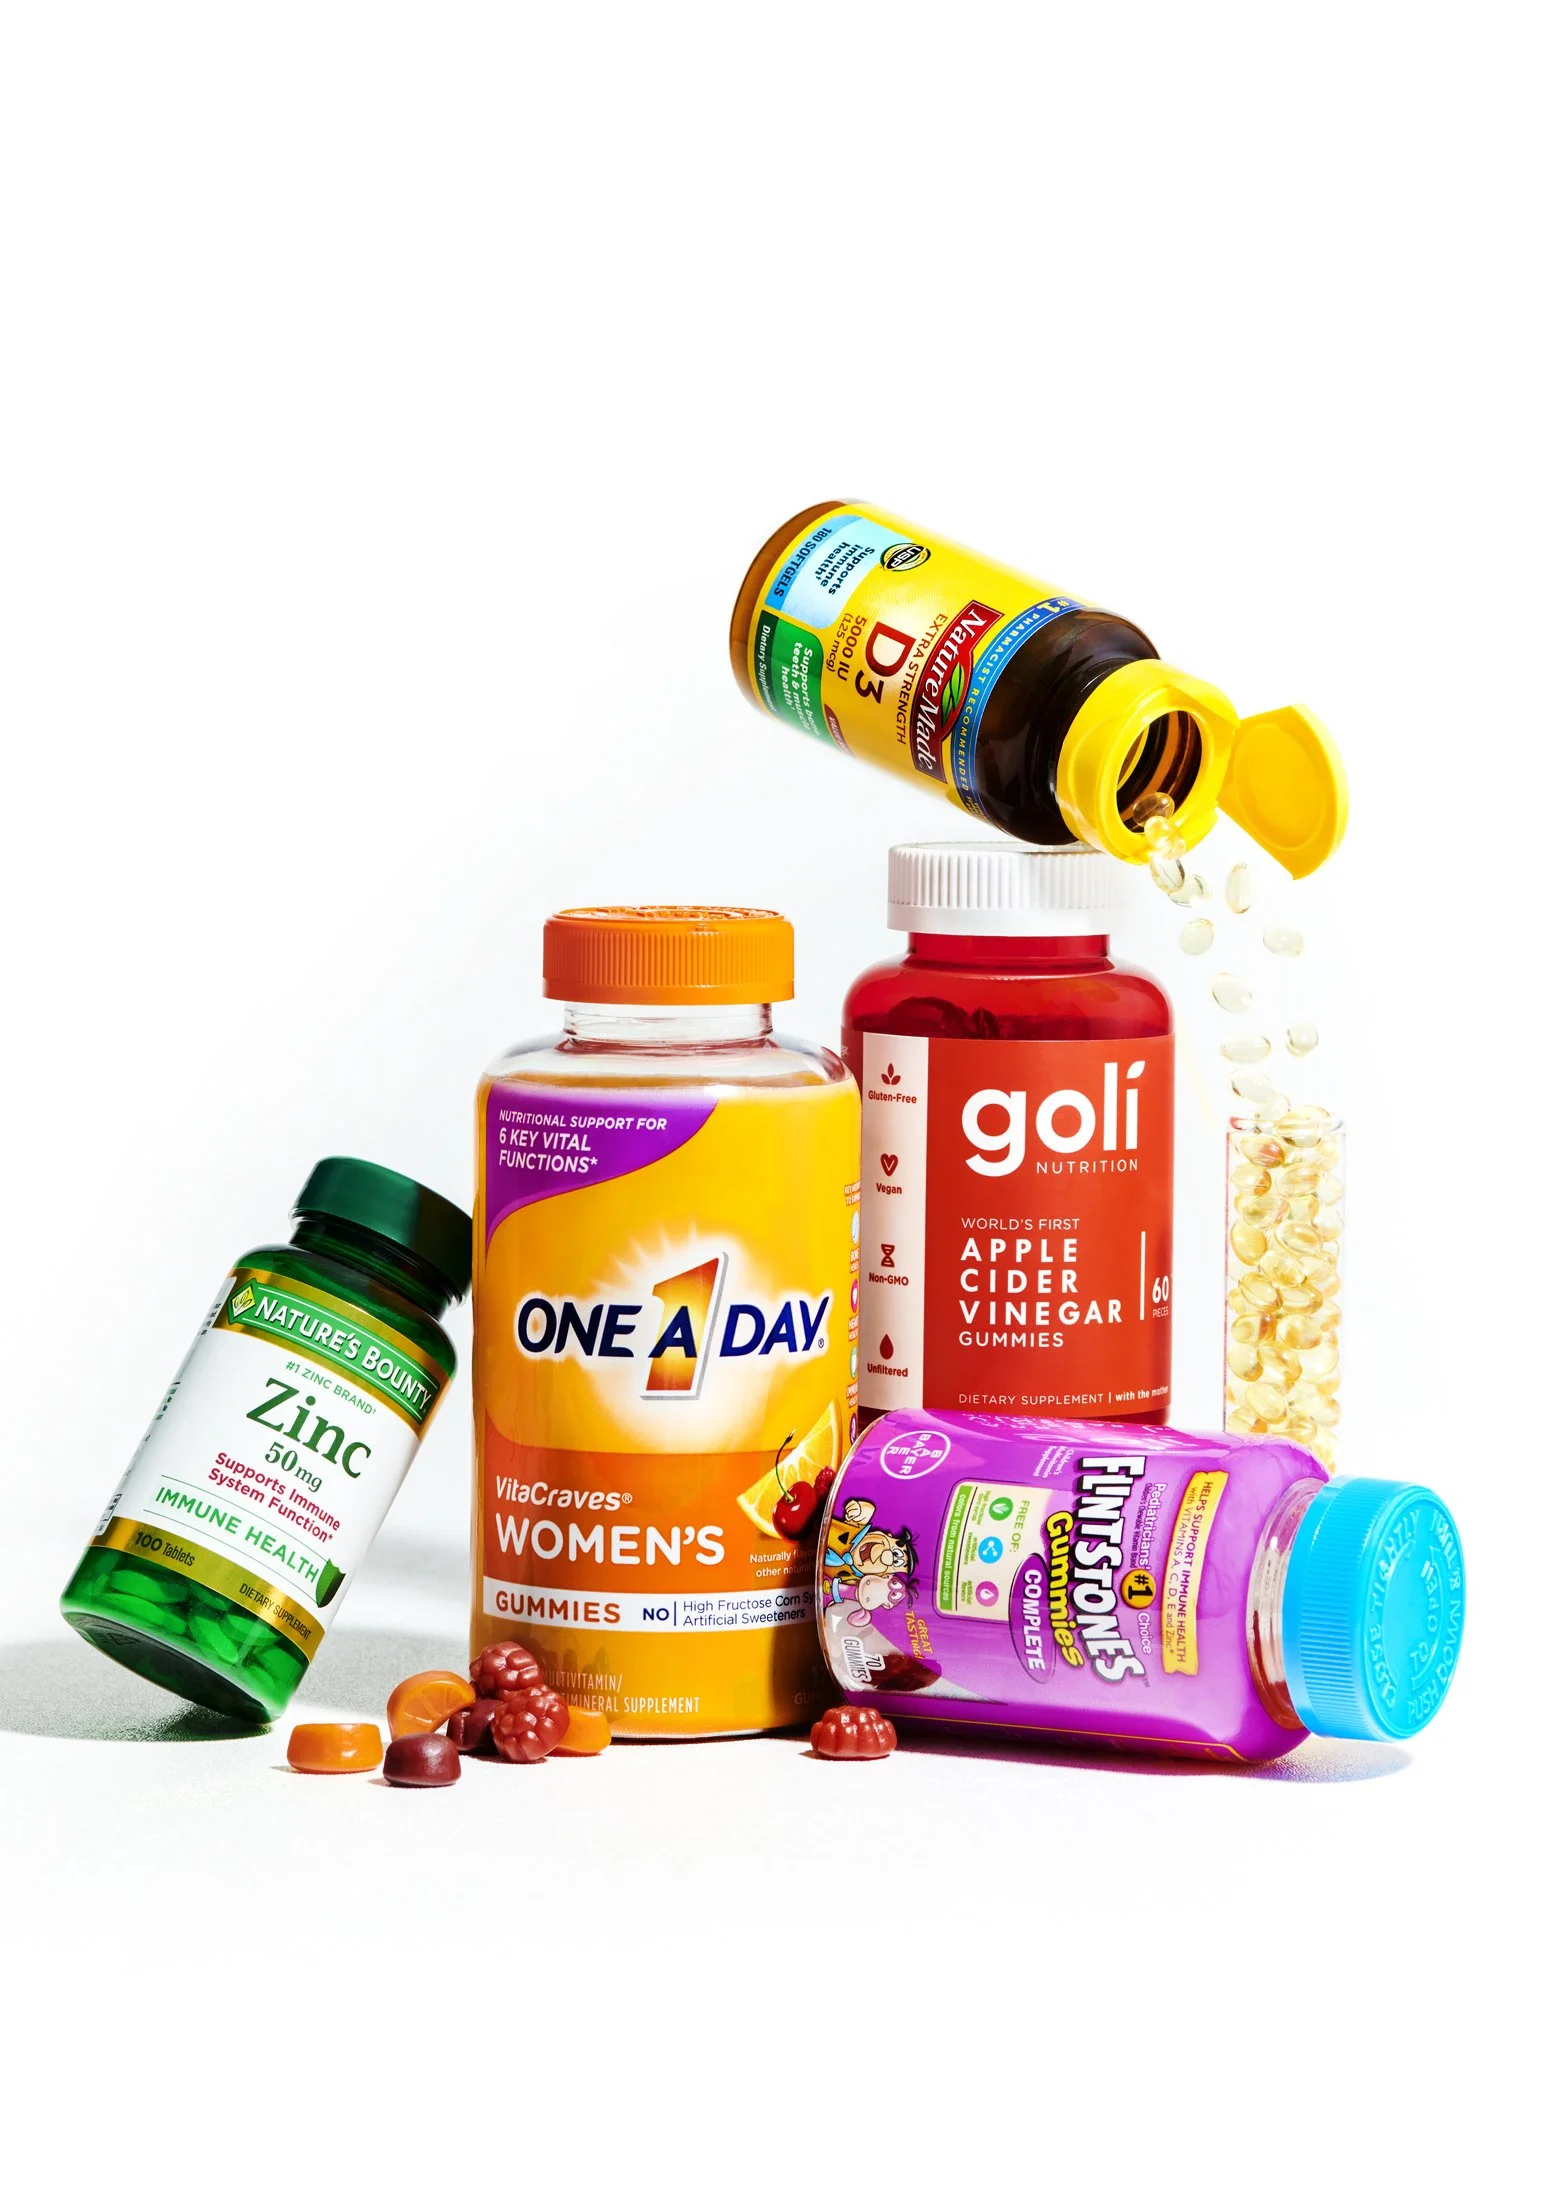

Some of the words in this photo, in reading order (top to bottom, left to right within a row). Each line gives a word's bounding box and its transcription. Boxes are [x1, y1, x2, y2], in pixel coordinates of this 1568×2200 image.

[812, 527, 832, 543] 180
[773, 540, 817, 597] SOFTGELS
[820, 544, 863, 588] immune
[828, 546, 875, 595] Supports
[890, 546, 922, 568] USP
[1036, 599, 1070, 614] #1
[836, 613, 853, 639] (125
[842, 615, 867, 659] 5000
[912, 613, 948, 658] EXTRA
[758, 624, 771, 661] Dietary
[826, 640, 840, 673] mcg)
[978, 613, 1041, 684] PHARMACIST
[791, 642, 803, 678] teeth
[837, 661, 850, 681] IU
[855, 621, 917, 704] D3
[791, 680, 799, 690] &
[801, 648, 813, 708] Supports
[896, 662, 919, 745] STRENGTH
[957, 688, 980, 791] RECOMMENDED
[868, 1090, 917, 1104] Gluten-Free
[499, 1109, 567, 1128] NUTRITIONAL
[570, 1115, 634, 1130] SUPPORT
[636, 1117, 667, 1131] FOR
[961, 1060, 1146, 1177] goli
[499, 1127, 507, 1144] 6
[509, 1130, 539, 1147] KEY
[542, 1132, 592, 1151] VITAL
[1036, 1158, 1138, 1175] NUTRITION
[876, 1182, 902, 1195] Vegan
[961, 1217, 1033, 1231] WORLD'S
[1039, 1217, 1080, 1230] FIRST
[960, 1237, 1078, 1262] APPLE
[868, 1271, 909, 1287] Non-GMO
[960, 1267, 1078, 1294] CIDER
[1152, 1275, 1169, 1304] 60
[517, 1297, 643, 1358] ONE
[648, 1305, 697, 1358] A
[958, 1299, 1123, 1326] VINEGAR
[1152, 1306, 1169, 1318] PIECES
[254, 1296, 361, 1360] NATURE'S
[361, 1345, 432, 1410] BOUNTY
[958, 1330, 1064, 1348] GUMMIES
[286, 1361, 300, 1372] #1
[302, 1368, 332, 1389] ZINC
[867, 1362, 908, 1378] Unfiltered
[958, 1392, 1017, 1405] DIETARY
[1021, 1393, 1104, 1406] SUPPLEMENT
[1115, 1390, 1135, 1402] with
[1137, 1389, 1150, 1400] the
[246, 1377, 372, 1479] Zinc
[264, 1442, 298, 1472] 50
[295, 1466, 323, 1493] mg
[208, 1468, 265, 1503] System
[215, 1452, 286, 1494] Supports
[289, 1489, 341, 1531] Immune
[1185, 1487, 1197, 1505] with
[1198, 1481, 1214, 1511] HELPS
[954, 1494, 966, 1517] colors
[1014, 1500, 1030, 1530] FREE
[155, 1487, 242, 1534] IMMUNE
[244, 1526, 320, 1583] HEALTH
[495, 1513, 725, 1566] WOMEN'S
[950, 1518, 960, 1538] from
[1010, 1532, 1021, 1552] OF:
[1139, 1483, 1167, 1570] Pediatricians'
[1174, 1506, 1192, 1556] VITAMINS
[1185, 1513, 1203, 1566] SUPPORT
[134, 1531, 163, 1551] 100
[161, 1542, 195, 1567] Tablets
[749, 1551, 792, 1564] Naturally
[945, 1538, 957, 1569] natural
[755, 1567, 781, 1578] other
[942, 1570, 951, 1601] sources
[1072, 1456, 1147, 1684] FLINTSTONES
[1046, 1511, 1085, 1667] Gummies
[1127, 1574, 1153, 1600] #1
[1177, 1570, 1191, 1618] IMMUNE
[239, 1583, 274, 1610] DIETARY
[275, 1605, 312, 1641] SUPPLEMENT
[495, 1589, 621, 1624] GUMMIES
[642, 1607, 669, 1621] NO
[683, 1600, 714, 1614] High
[718, 1596, 772, 1612] Fructose
[775, 1594, 800, 1607] Corn
[683, 1612, 738, 1627] Artificial
[741, 1607, 806, 1624] Sweeteners
[1023, 1569, 1046, 1670] COMPLETE
[1166, 1612, 1174, 1628] and
[905, 1611, 925, 1660] TASTING!
[917, 1618, 933, 1654] GREAT
[1136, 1612, 1152, 1655] Choice
[1176, 1620, 1187, 1663] HEALTH
[844, 1639, 868, 1679] GUMMIES
[865, 1655, 882, 1668] 70
[1369, 1623, 1397, 1708] CLOSE
[1406, 1680, 1440, 1725] PUSH
[1436, 1600, 1461, 1684] DOWN
[1410, 1641, 1428, 1671] TO
[623, 1696, 700, 1714] SUPPLEMENT
